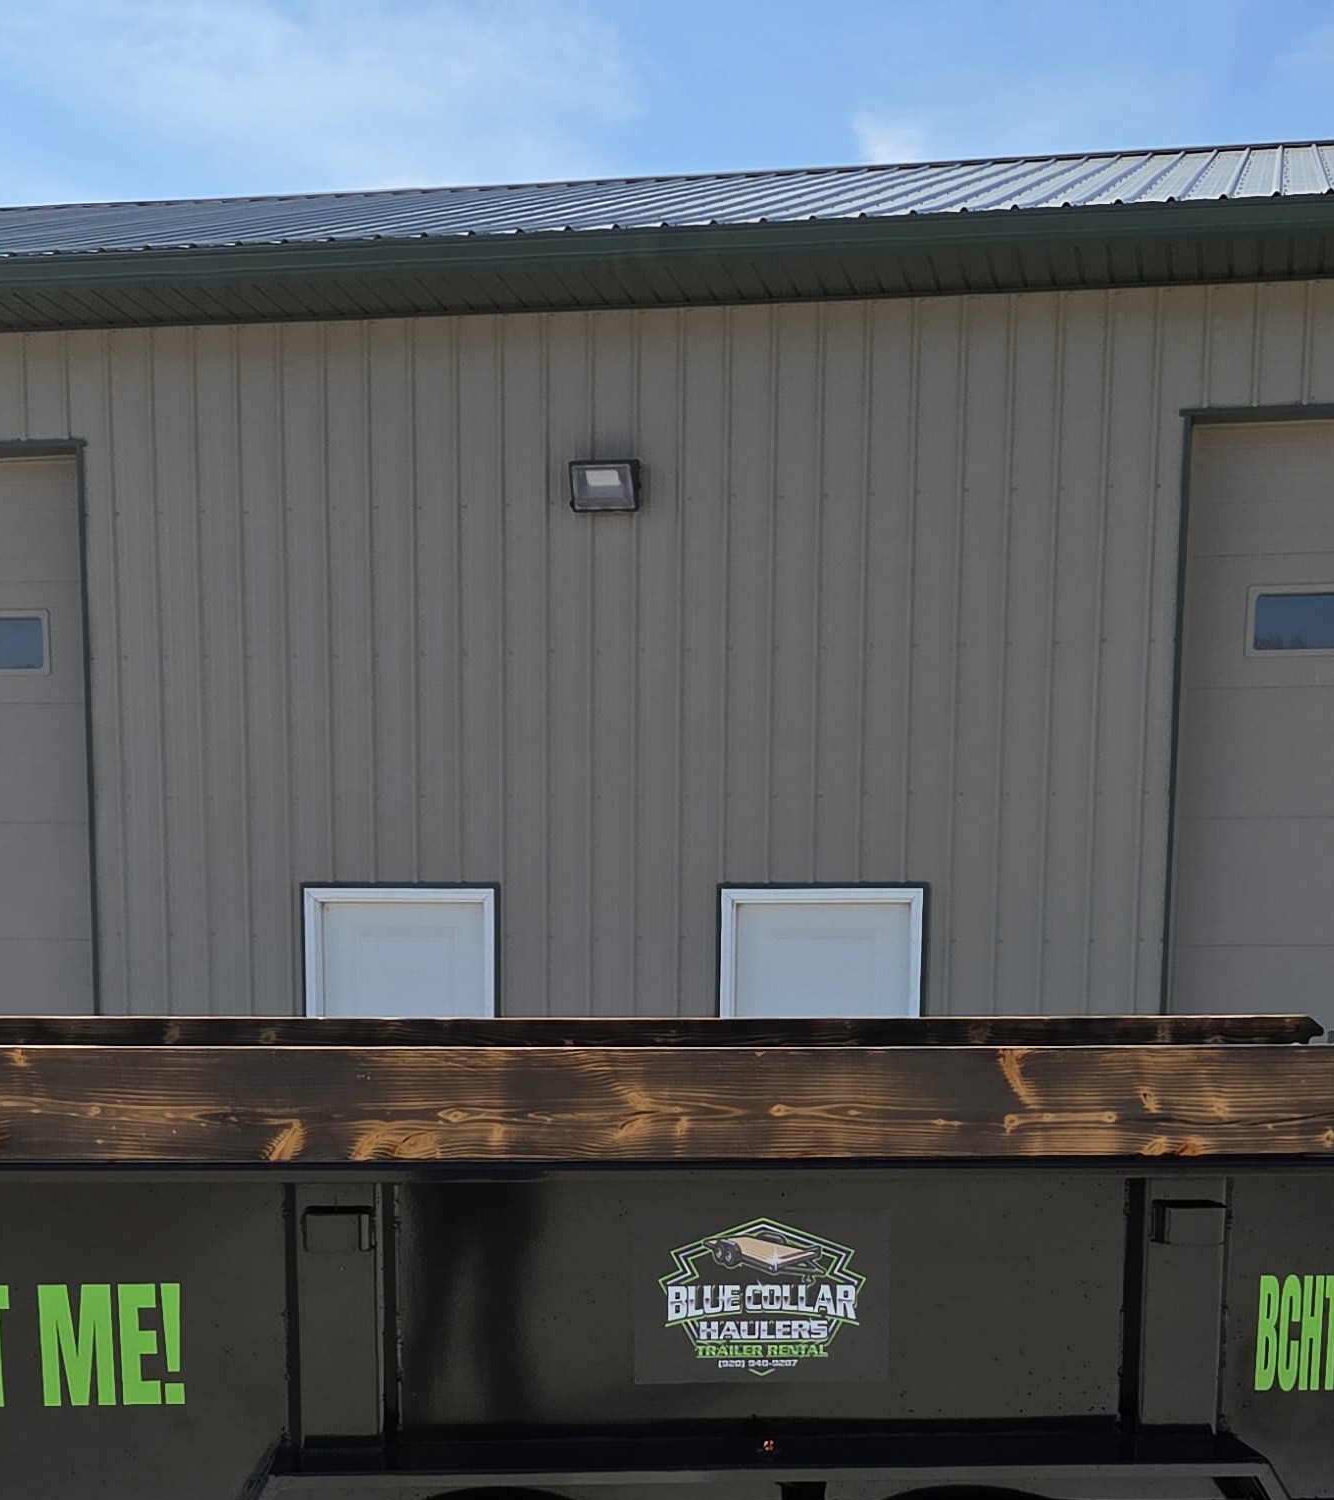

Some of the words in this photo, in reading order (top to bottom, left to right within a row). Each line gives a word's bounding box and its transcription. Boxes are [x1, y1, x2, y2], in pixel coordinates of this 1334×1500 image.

[667, 1284, 741, 1322] BLUE
[745, 1284, 857, 1319] COLLAR
[699, 1320, 828, 1339] HAULERS
[38, 1284, 185, 1406] ME!
[697, 1344, 763, 1356] TRAILER
[767, 1344, 827, 1356] RENTAL
